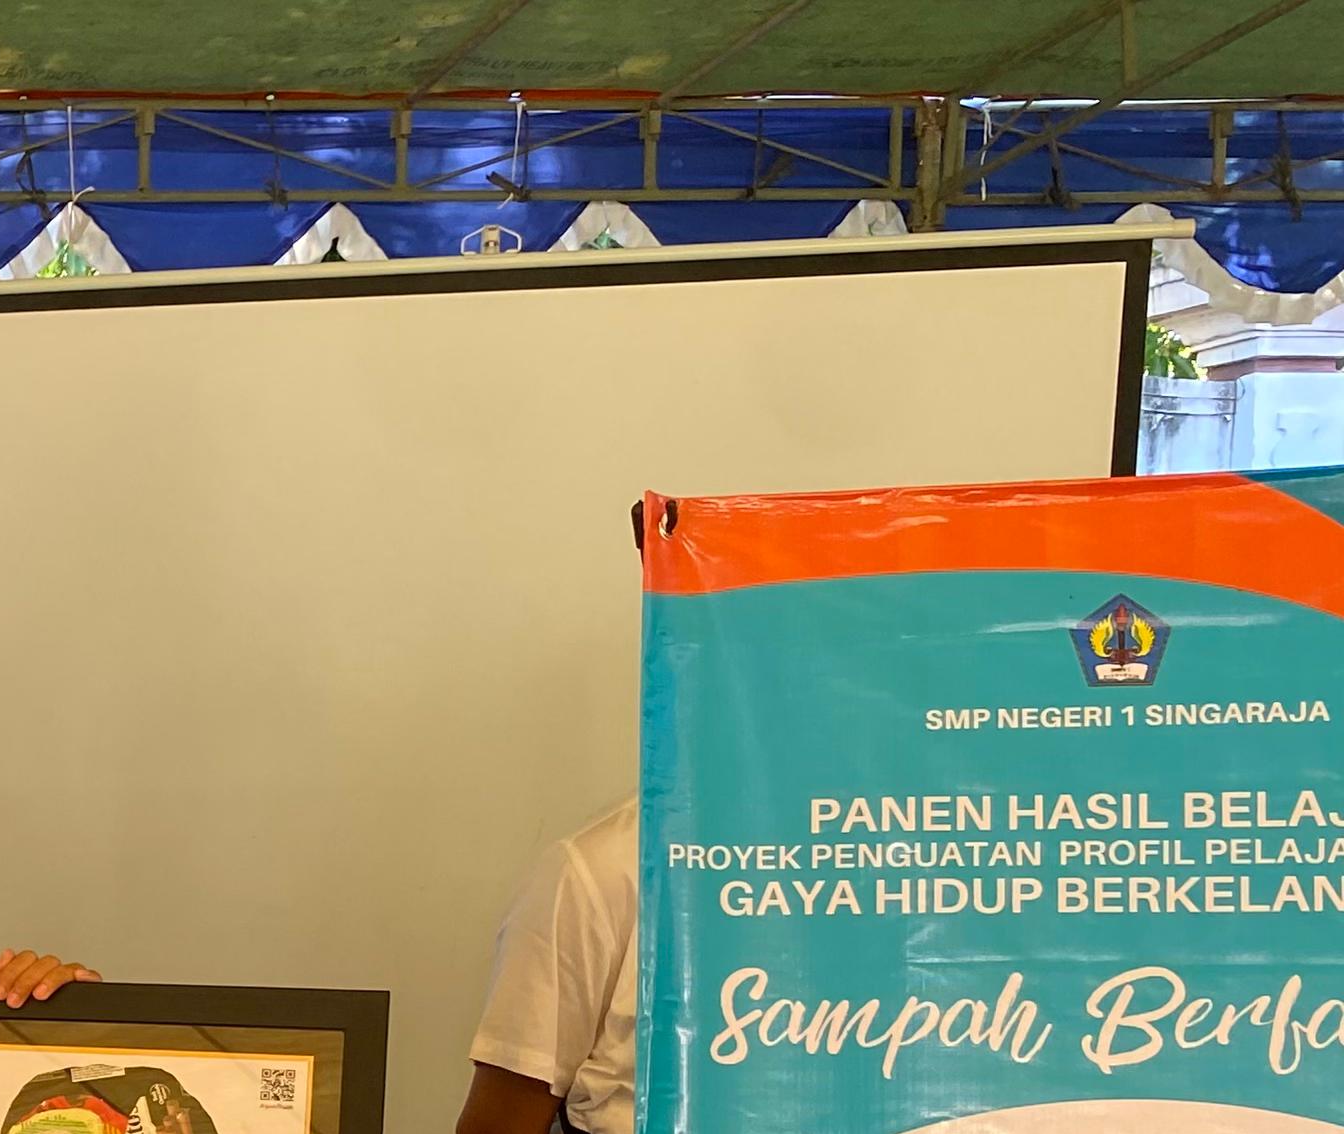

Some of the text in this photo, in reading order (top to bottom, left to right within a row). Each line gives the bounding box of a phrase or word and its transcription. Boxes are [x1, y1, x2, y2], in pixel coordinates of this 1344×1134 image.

[925, 701, 1330, 729] SMP NEGERI 1 SINGARAJA
[810, 796, 992, 833] PANEN
[1008, 793, 1168, 830] HASIL
[668, 845, 801, 871] PROYEK
[812, 841, 1041, 869] PENGUATAN
[1060, 840, 1194, 865] PROFIL
[719, 876, 1344, 917] GAYA HIDUP BERKELAN
[710, 966, 1344, 1079] Sampah Berfa
